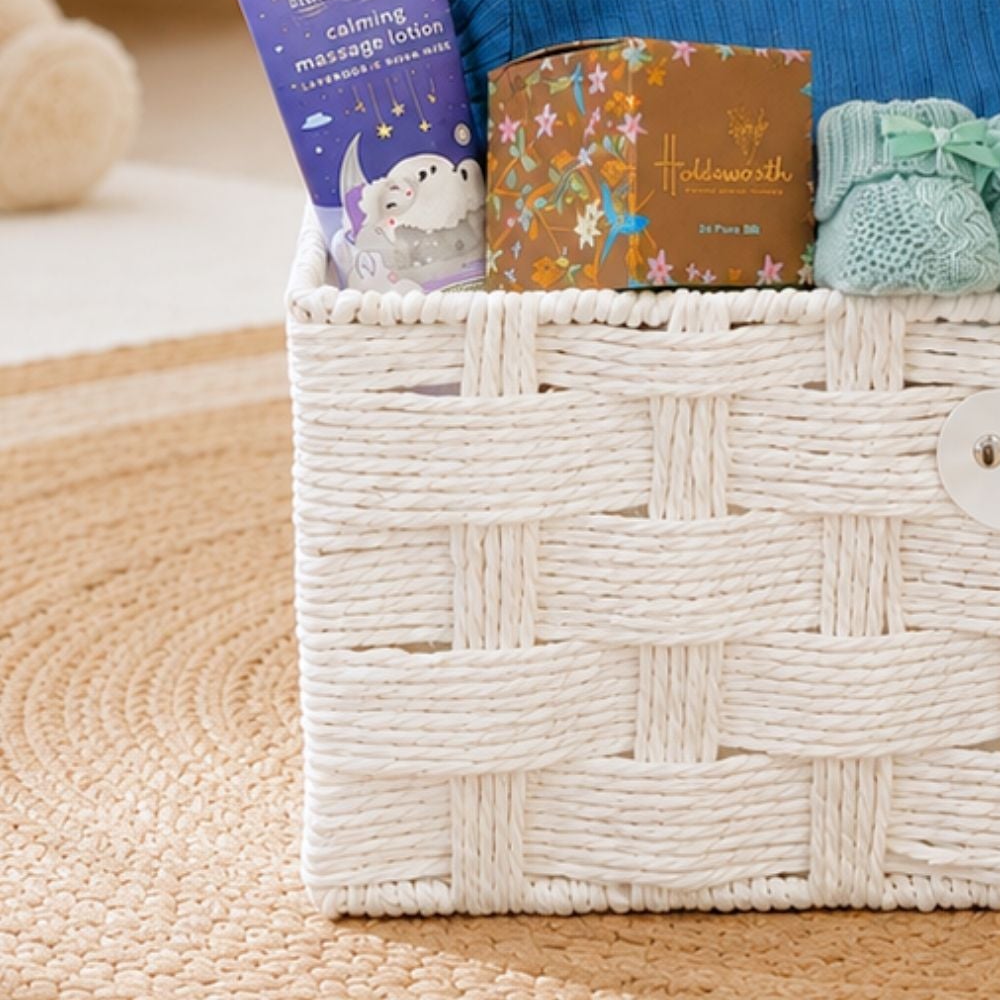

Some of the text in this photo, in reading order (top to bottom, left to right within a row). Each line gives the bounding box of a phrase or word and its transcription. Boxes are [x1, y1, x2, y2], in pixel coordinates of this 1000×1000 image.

[326, 6, 408, 40] calming
[294, 36, 384, 74] massage
[387, 20, 445, 46] lotion
